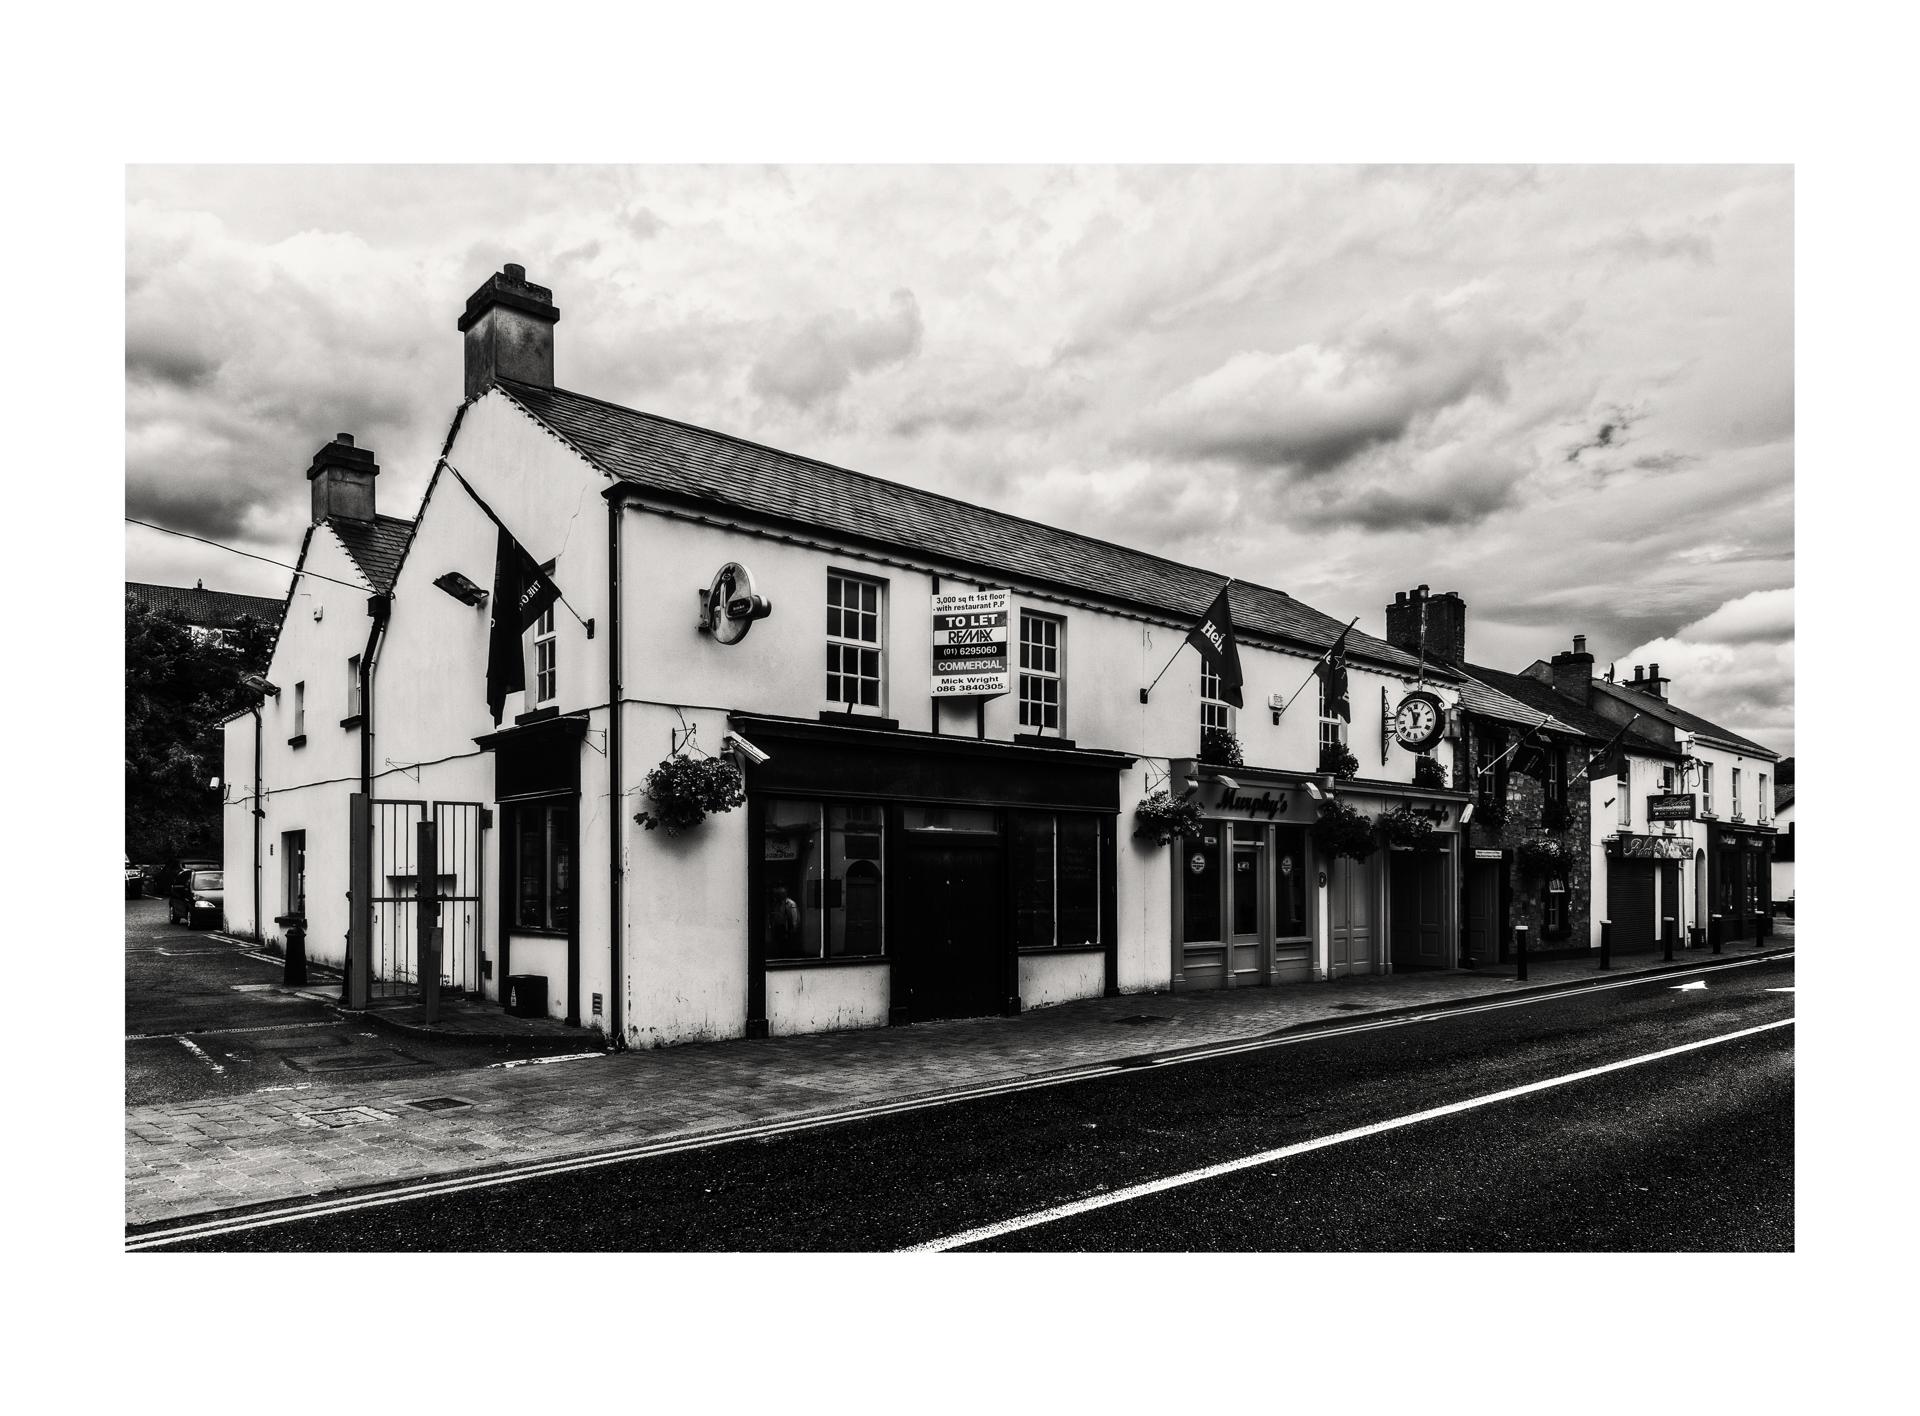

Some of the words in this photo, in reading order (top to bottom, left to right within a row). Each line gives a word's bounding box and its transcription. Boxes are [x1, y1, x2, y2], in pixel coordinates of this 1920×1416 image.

[936, 596, 956, 605] 3,000
[989, 593, 1006, 601] floor
[936, 604, 952, 612] with
[953, 602, 992, 611] restaurant
[993, 600, 1005, 608] P.P
[945, 616, 966, 628] TO
[970, 613, 998, 627] LET
[943, 647, 958, 656] (01)
[959, 645, 998, 656] 6295060
[938, 659, 1003, 672] COMMERCIAL
[941, 677, 964, 685] Mick
[966, 675, 999, 685] Wright
[936, 685, 956, 693] 086
[958, 683, 1004, 692] 3840305
[1215, 787, 1288, 820] Murphy's
